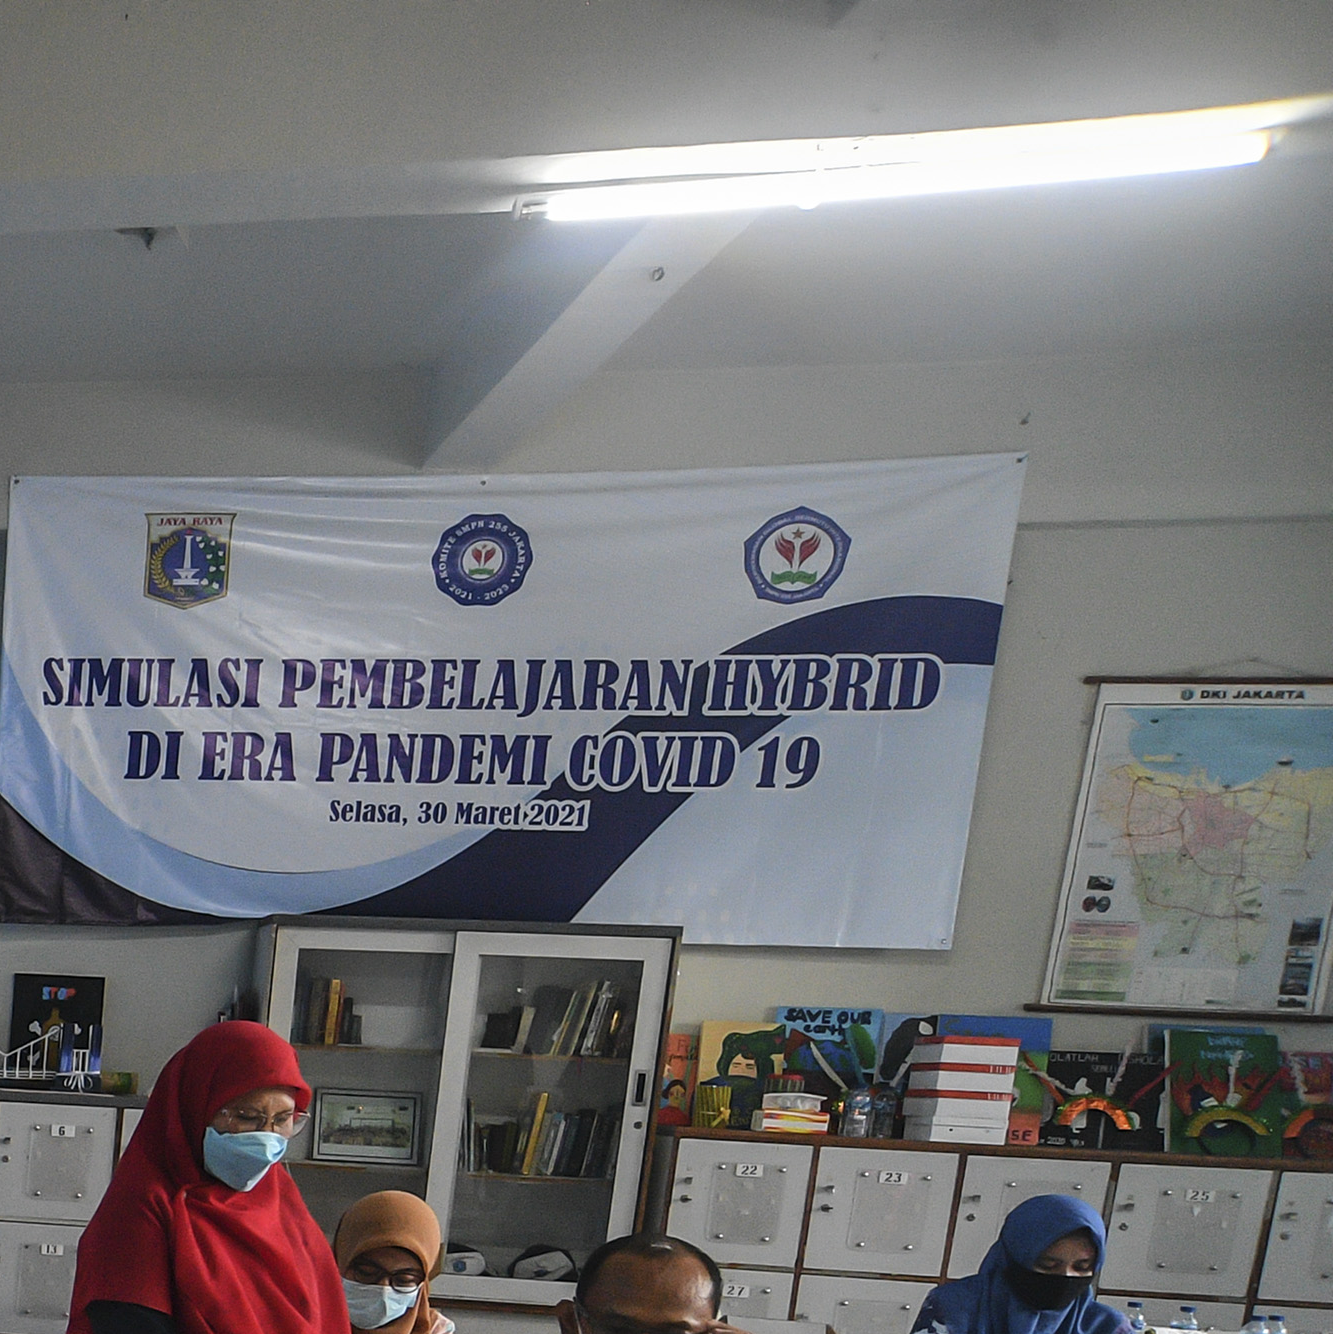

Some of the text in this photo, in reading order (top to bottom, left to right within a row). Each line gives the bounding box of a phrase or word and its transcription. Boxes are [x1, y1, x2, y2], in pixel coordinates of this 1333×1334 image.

[157, 516, 223, 526] JAYA RAYA
[439, 521, 525, 579] KOMITE SMPN 255 JAKARTA
[449, 584, 472, 600] 2021
[42, 657, 941, 718] SIMULASI PEMBELAJARAN HYBRID
[1200, 690, 1305, 699] DKI JAKARTA
[123, 730, 821, 789] DI ERA PANDEMI COVID 19
[329, 799, 586, 827] Selasa, 30 Maret 2021
[42, 986, 76, 1000] STOP
[784, 1008, 873, 1025] SAVE OUR
[58, 1126, 65, 1136] 6
[741, 1165, 758, 1175] 22
[884, 1172, 902, 1183] 23
[1190, 1190, 1210, 1201] 25
[726, 1286, 745, 1296] 27
